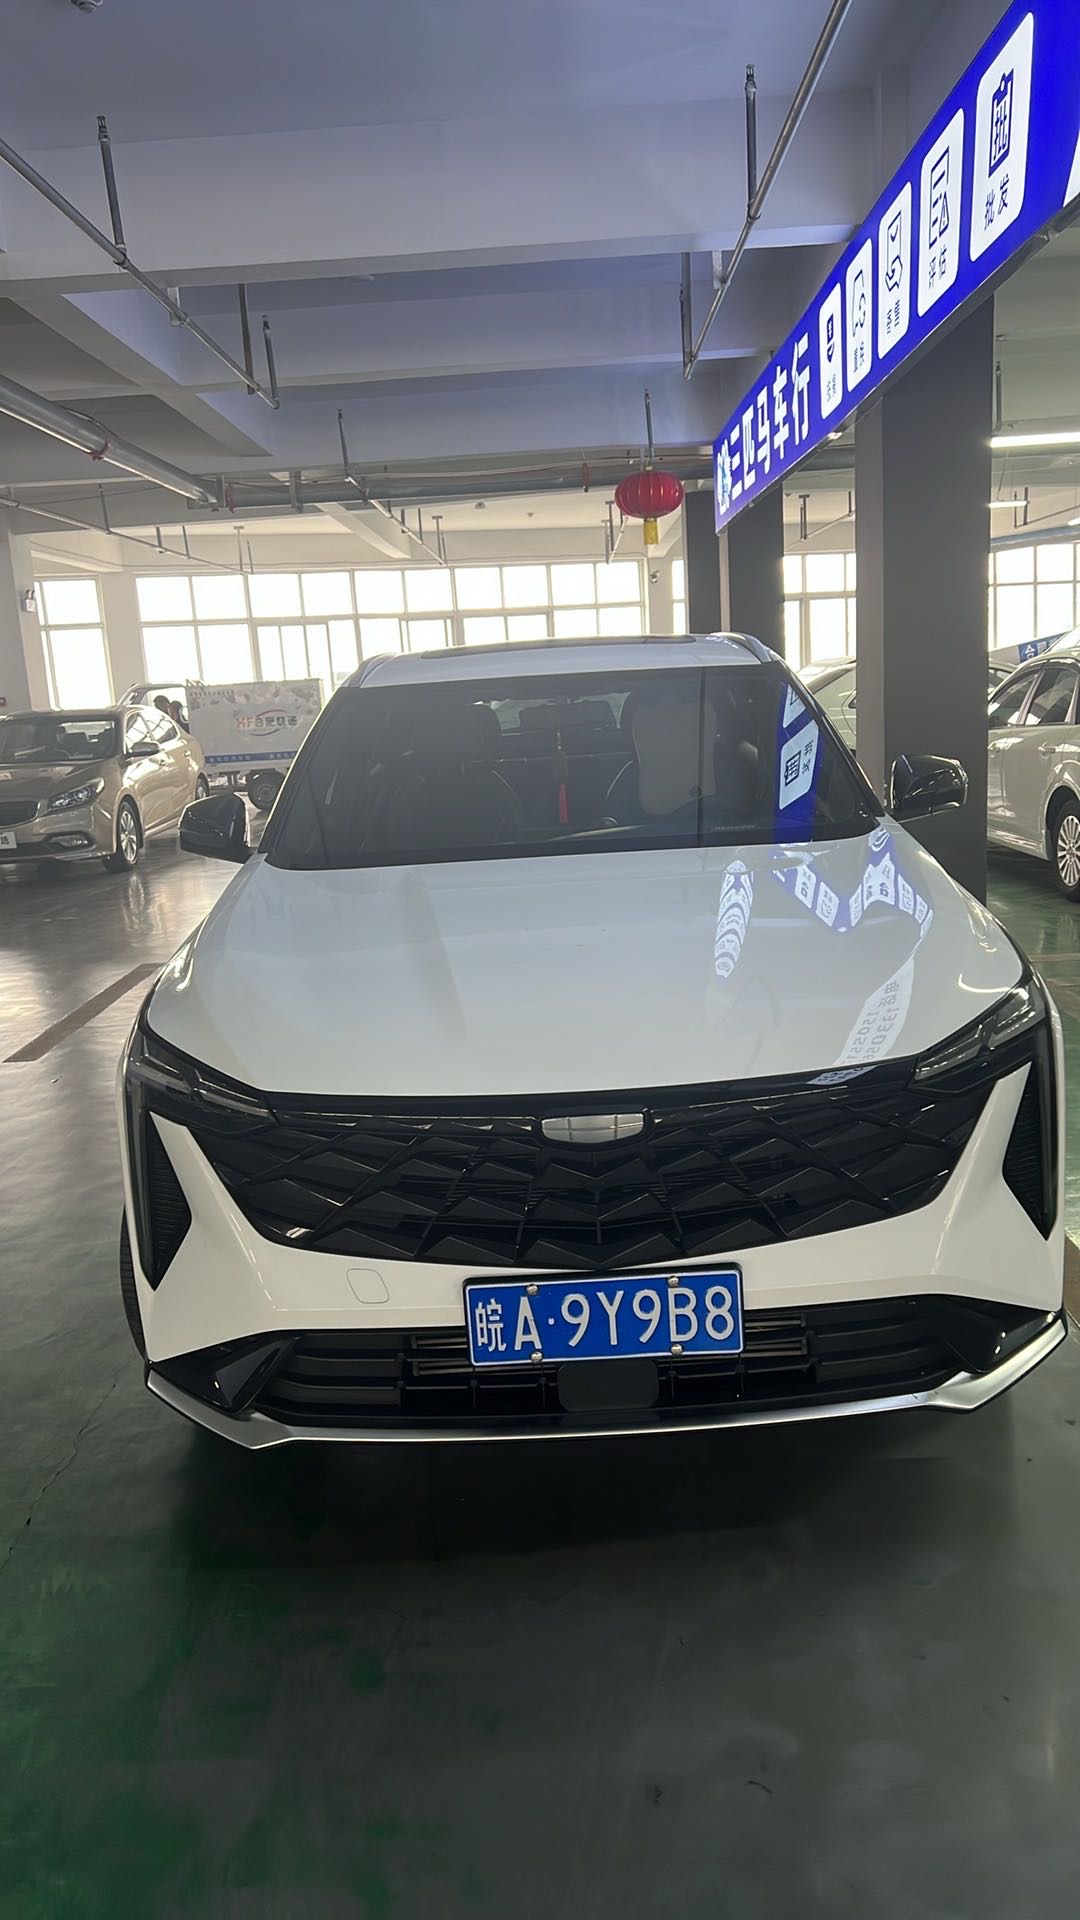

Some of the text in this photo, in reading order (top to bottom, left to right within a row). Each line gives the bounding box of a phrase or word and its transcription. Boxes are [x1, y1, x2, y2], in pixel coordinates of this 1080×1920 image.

[984, 173, 1010, 230] 批发
[928, 245, 947, 289] 评估
[730, 331, 811, 501] 三匹马车行
[475, 1285, 734, 1352] 皖A·9Y9B8
